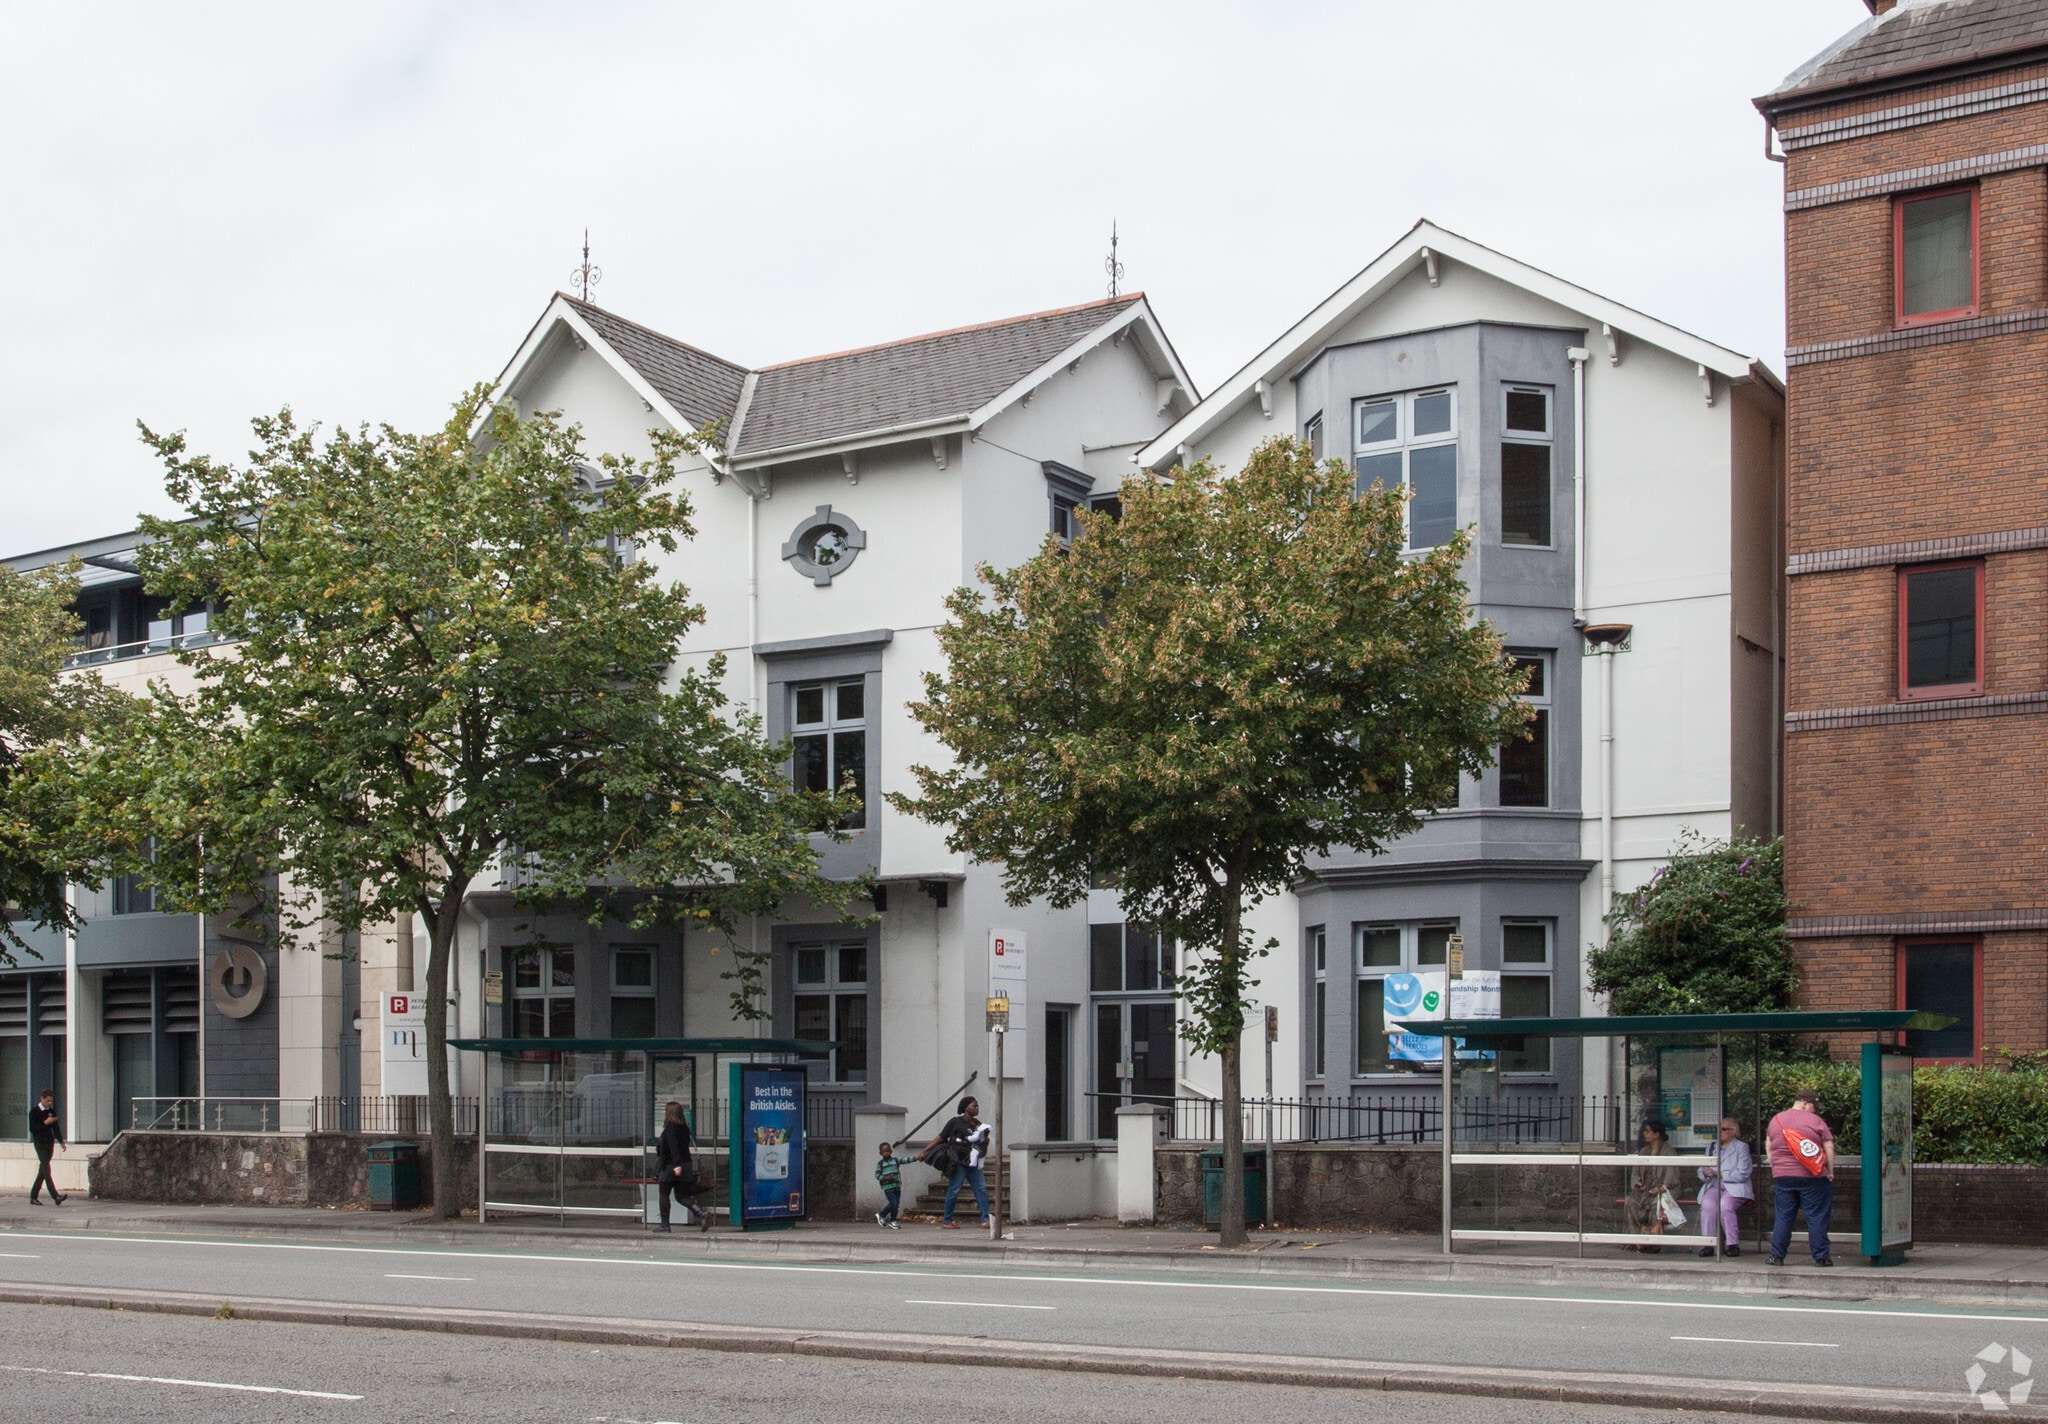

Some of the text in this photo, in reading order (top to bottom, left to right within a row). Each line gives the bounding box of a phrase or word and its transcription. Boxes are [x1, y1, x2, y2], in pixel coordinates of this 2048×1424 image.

[1620, 640, 1629, 651] 06
[1450, 984, 1479, 993] endship
[755, 1085, 793, 1097] Best in the
[750, 1099, 797, 1111] British Aisles.
